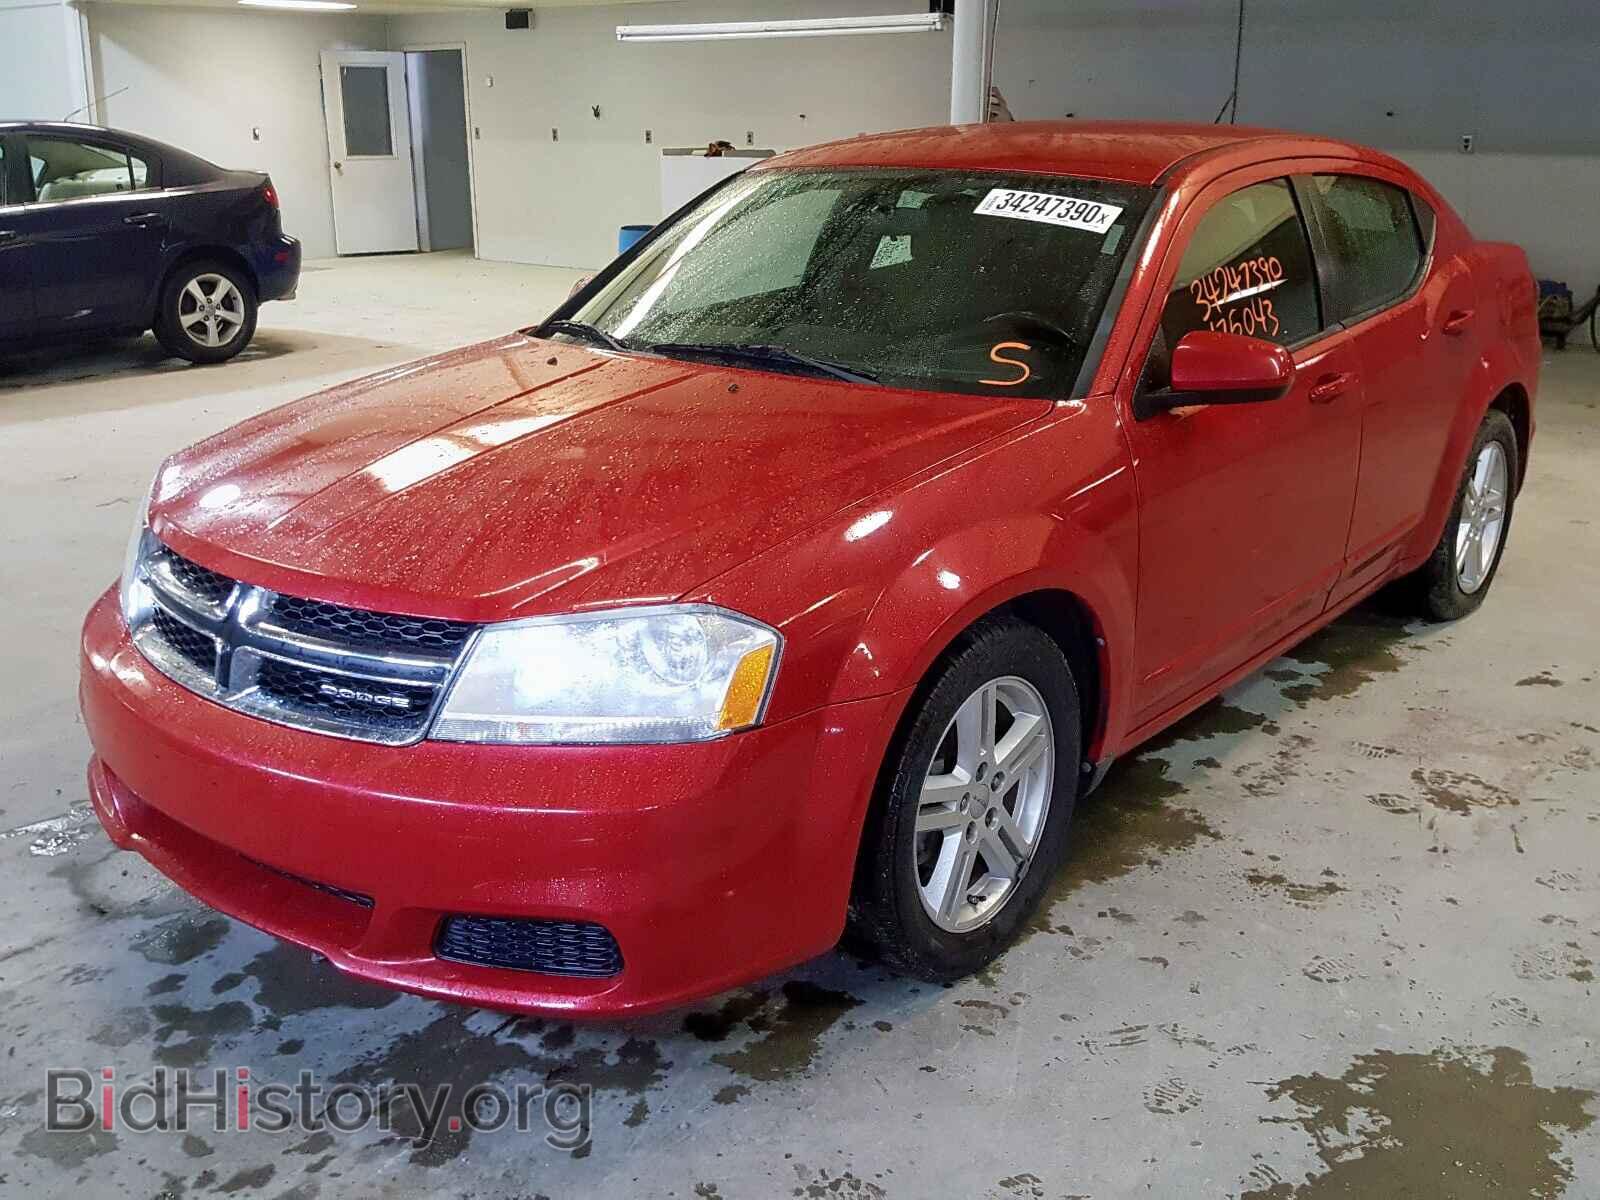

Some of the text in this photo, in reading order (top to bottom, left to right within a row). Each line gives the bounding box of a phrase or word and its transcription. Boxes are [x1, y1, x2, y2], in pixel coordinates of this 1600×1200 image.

[1190, 256, 1282, 322] 34247390
[978, 341, 1032, 386] S
[320, 684, 410, 708] DODGE
